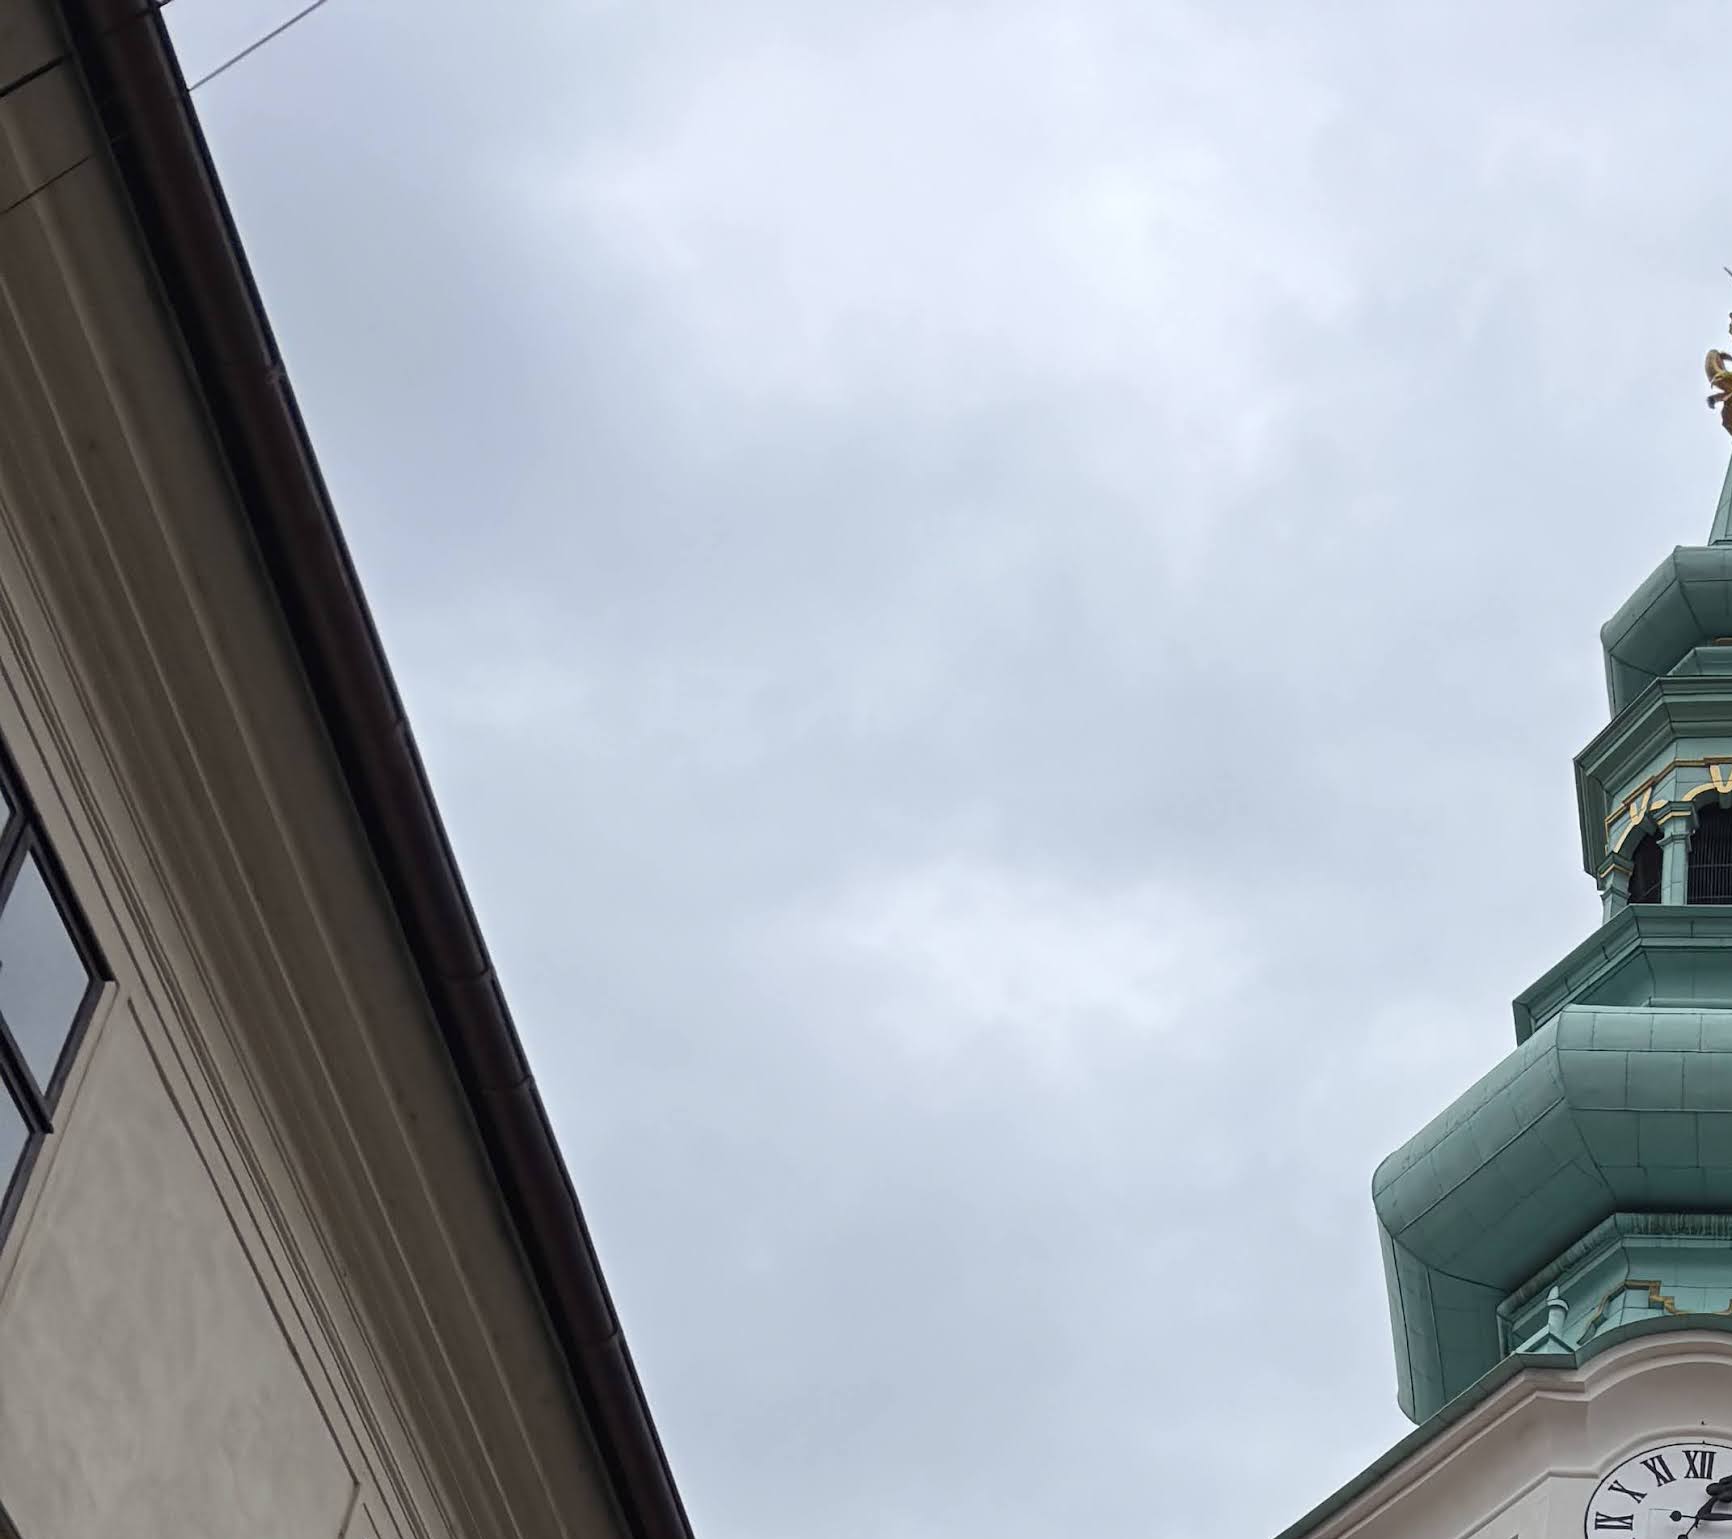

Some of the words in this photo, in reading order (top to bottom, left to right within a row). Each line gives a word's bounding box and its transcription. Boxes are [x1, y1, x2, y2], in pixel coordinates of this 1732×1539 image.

[1640, 1454, 1677, 1487] XI
[1682, 1450, 1716, 1480] XII
[1608, 1480, 1648, 1504] X
[1594, 1512, 1634, 1531] IX
